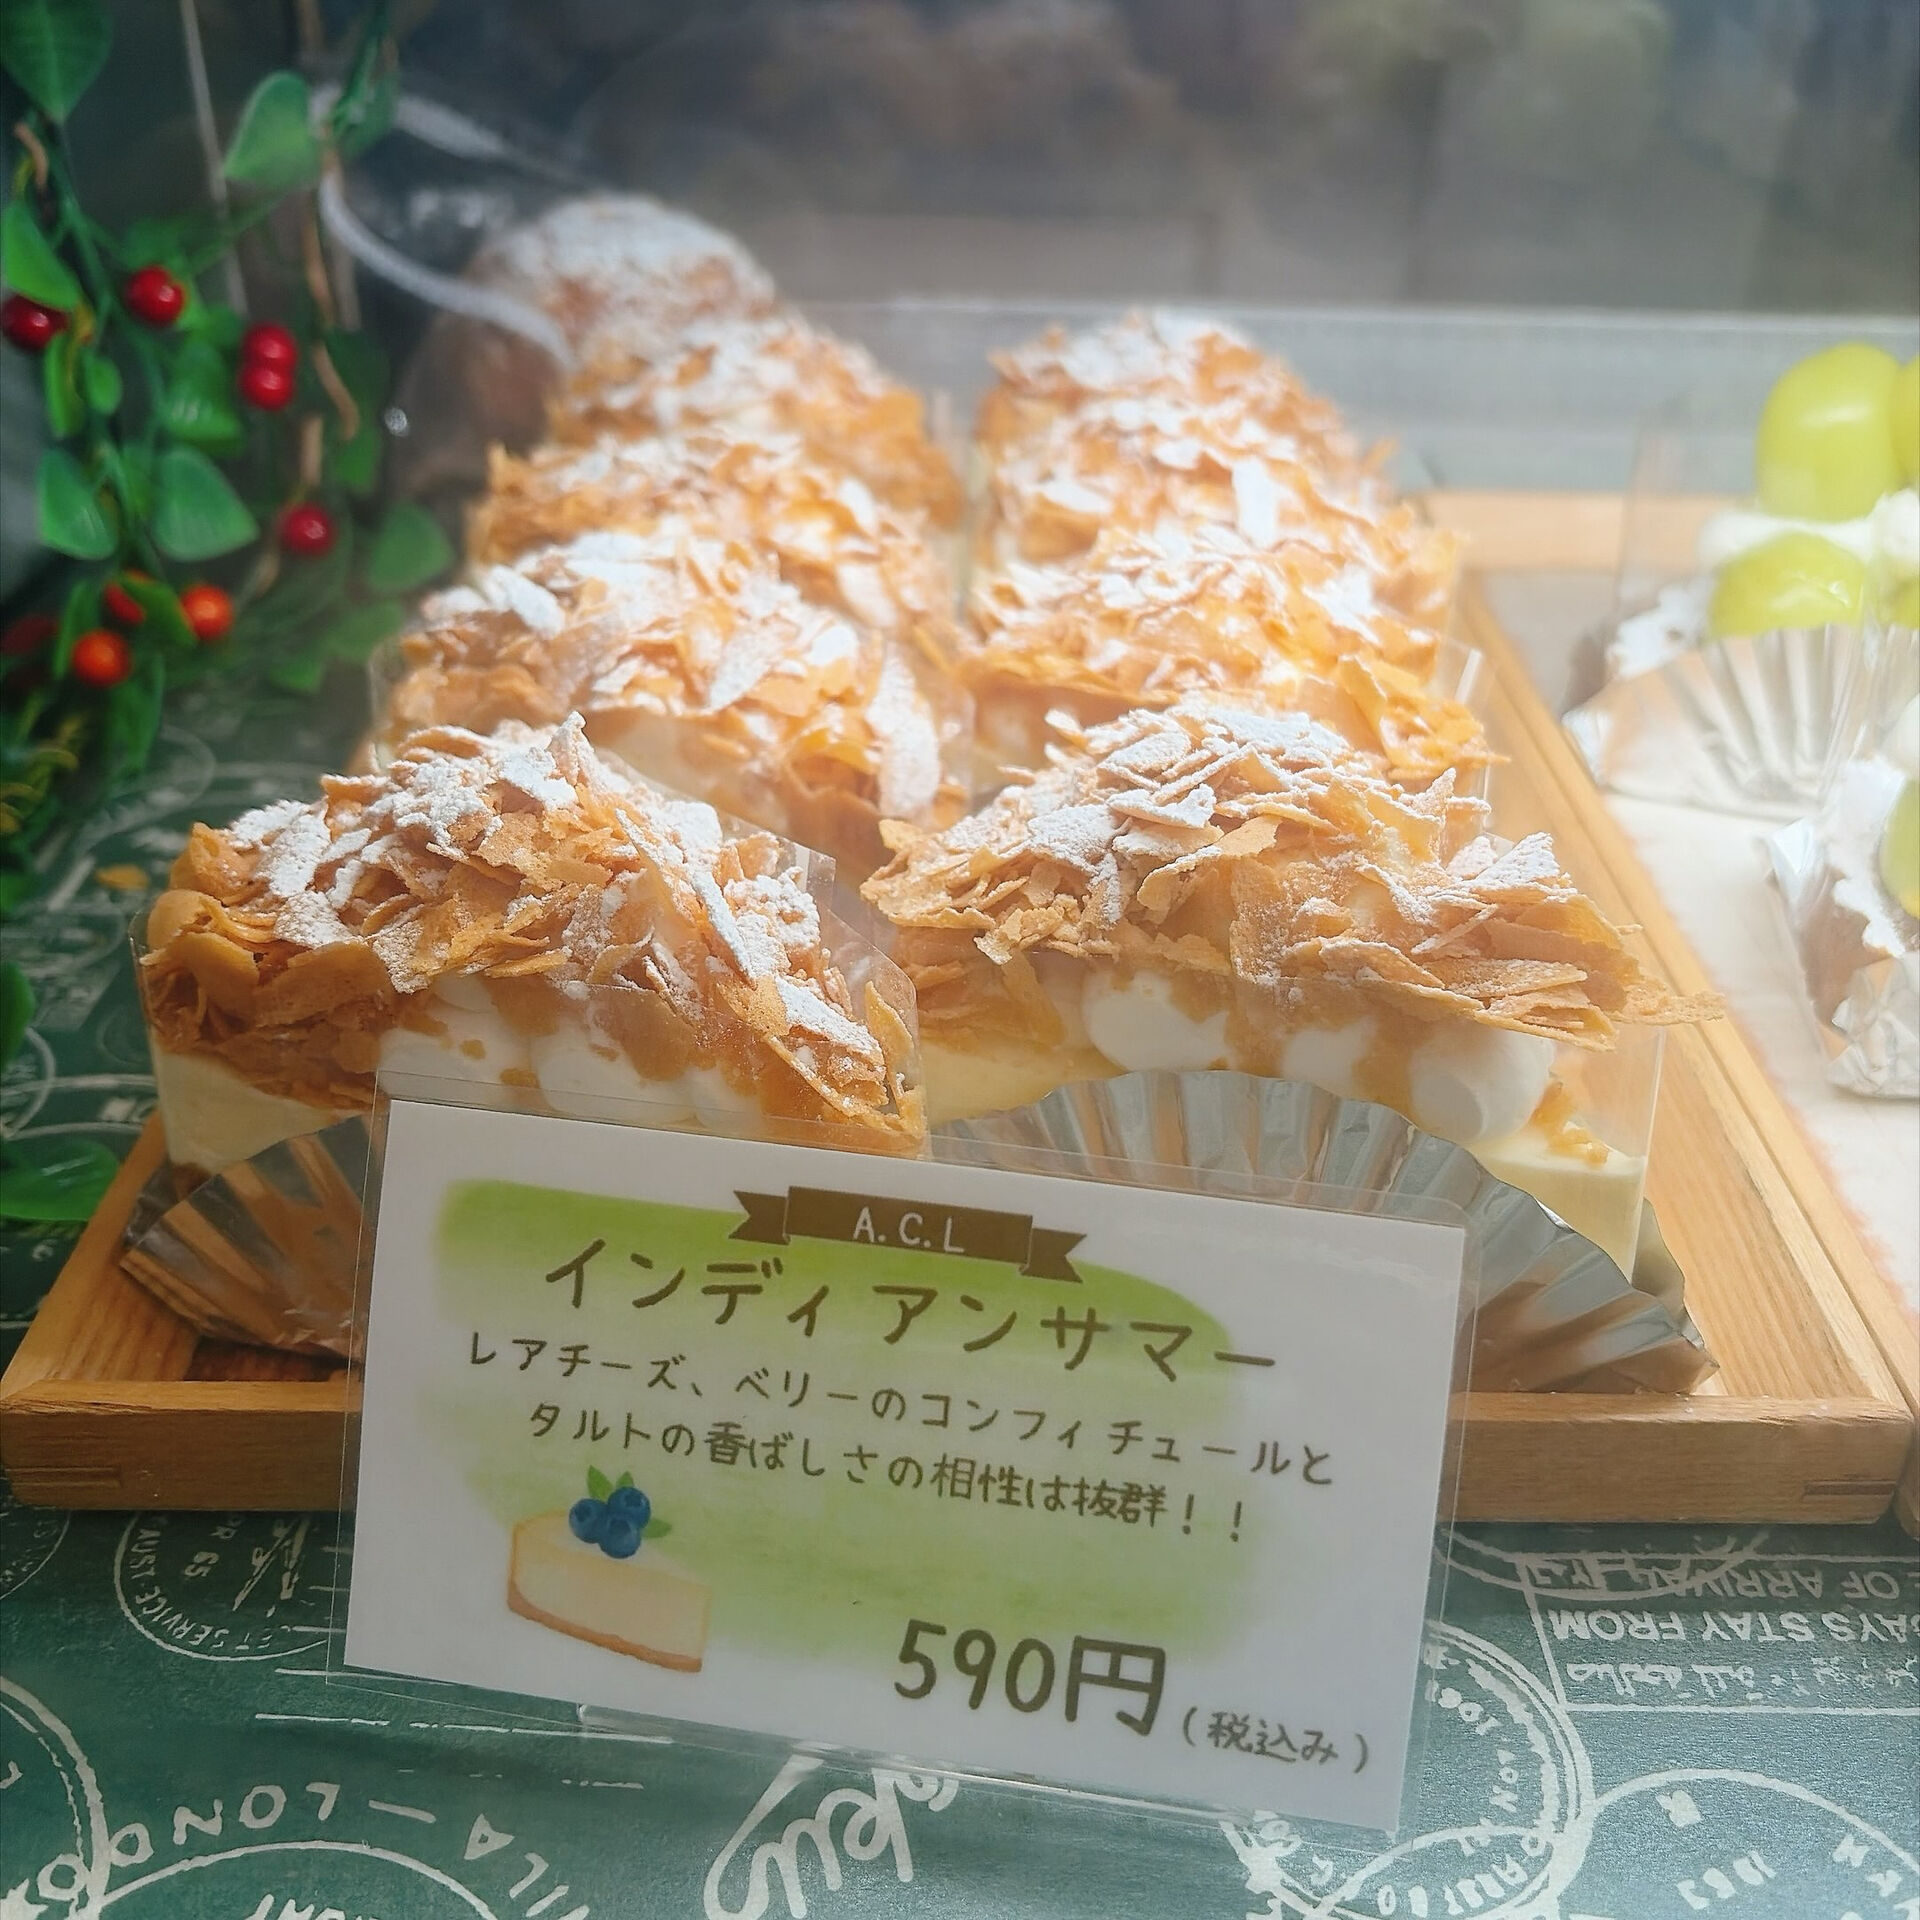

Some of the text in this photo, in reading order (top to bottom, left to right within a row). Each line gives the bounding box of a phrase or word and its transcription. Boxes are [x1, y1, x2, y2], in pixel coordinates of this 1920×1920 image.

[852, 1206, 965, 1254] A.C.L
[545, 1238, 1277, 1383] インディアンサマー
[470, 1331, 1334, 1487] レアチーズ、ベリーのコンフィチュールと
[530, 1402, 1244, 1544] タルトの香ばしさの相性は抜群！！
[1840, 1570, 1900, 1599] OF
[134, 1585, 230, 1649] SERVICE
[1547, 1609, 1687, 1641] FROM
[1701, 1610, 1816, 1643] STAY
[893, 1617, 1168, 1738] 590円
